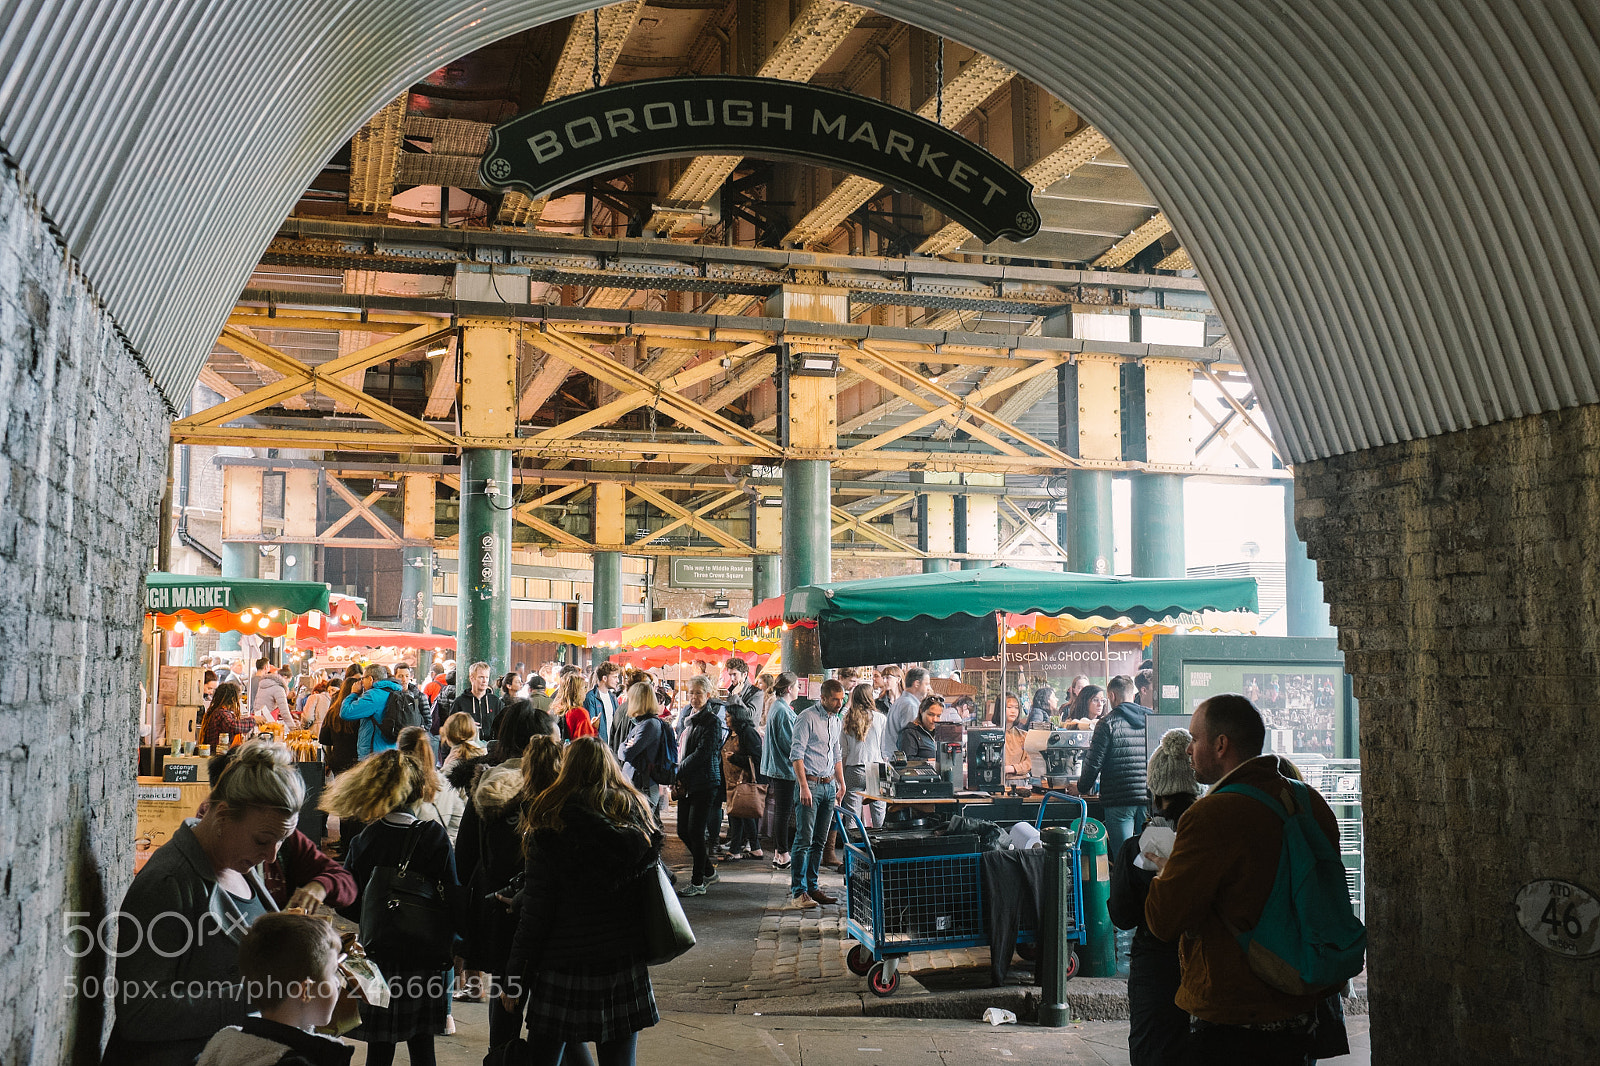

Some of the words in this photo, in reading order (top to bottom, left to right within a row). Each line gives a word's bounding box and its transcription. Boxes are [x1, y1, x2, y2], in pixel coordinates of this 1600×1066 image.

[526, 99, 793, 165] BOROUGH
[811, 108, 1008, 207] MARKET
[172, 587, 231, 607] MARKET
[1058, 651, 1128, 662] CHOCOLAT
[1041, 663, 1067, 671] LONDON
[1549, 882, 1570, 898] XTD
[1541, 897, 1583, 939] 46
